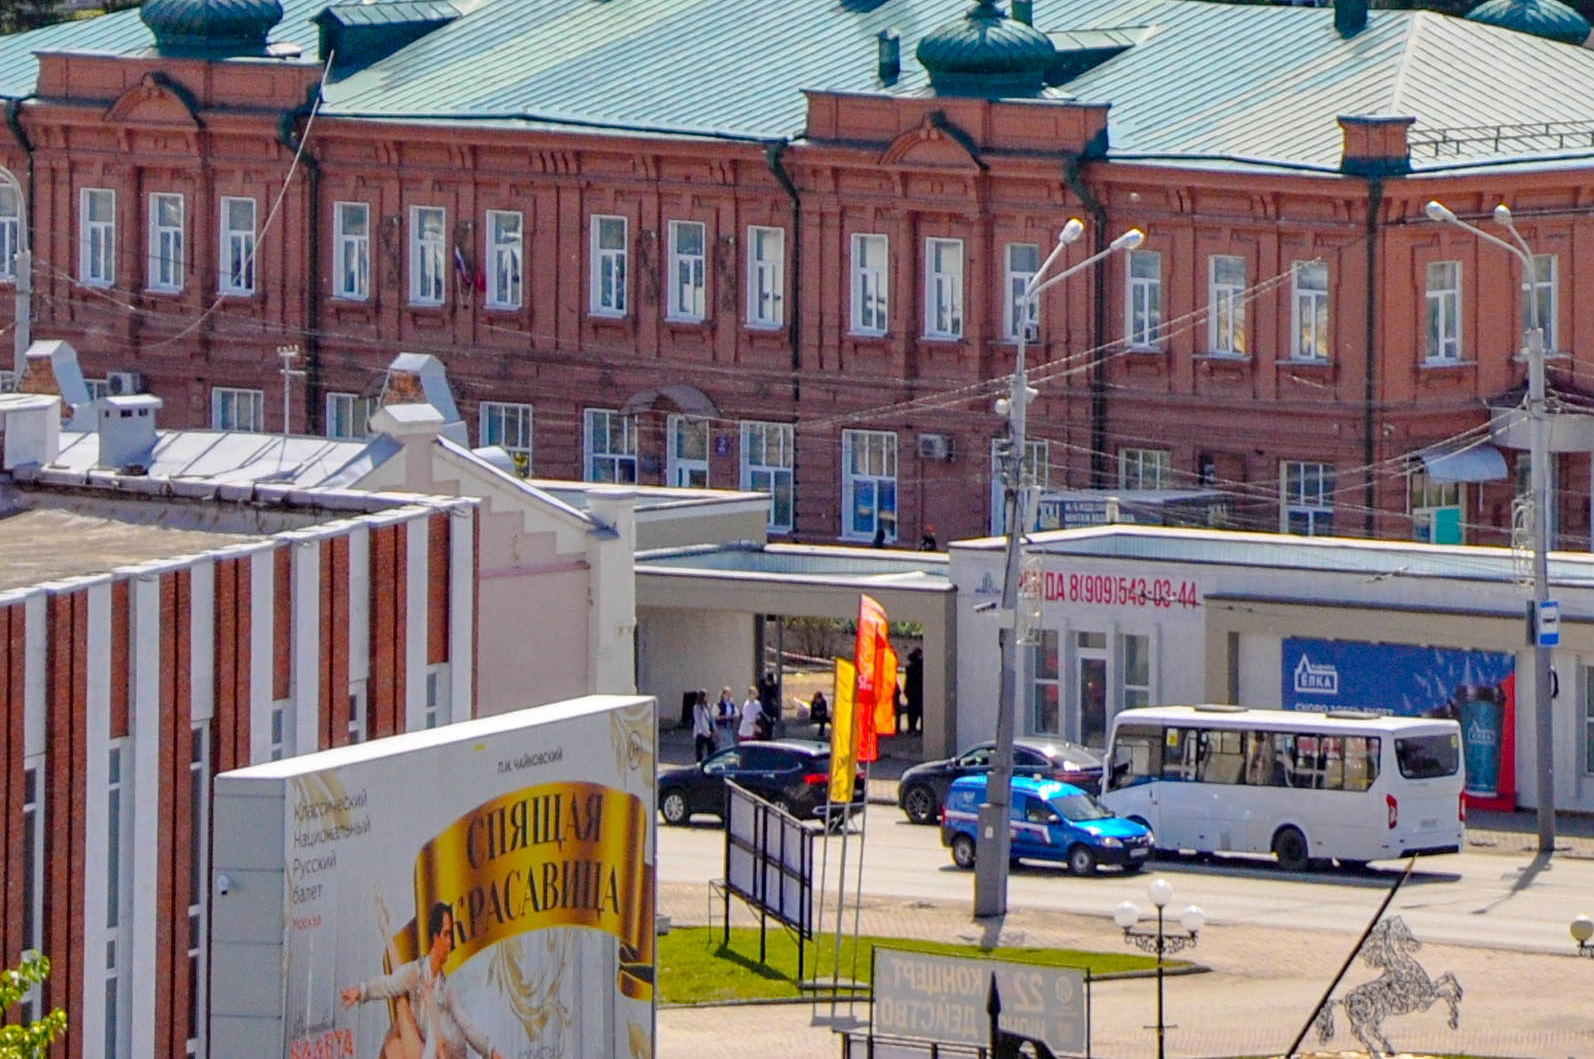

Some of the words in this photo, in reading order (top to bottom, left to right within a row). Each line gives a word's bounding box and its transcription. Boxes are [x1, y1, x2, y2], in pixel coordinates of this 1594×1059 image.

[292, 849, 337, 879] Русский
[466, 791, 604, 869] СПЯЩАЯ
[448, 860, 620, 952] КРАСАВИЦА
